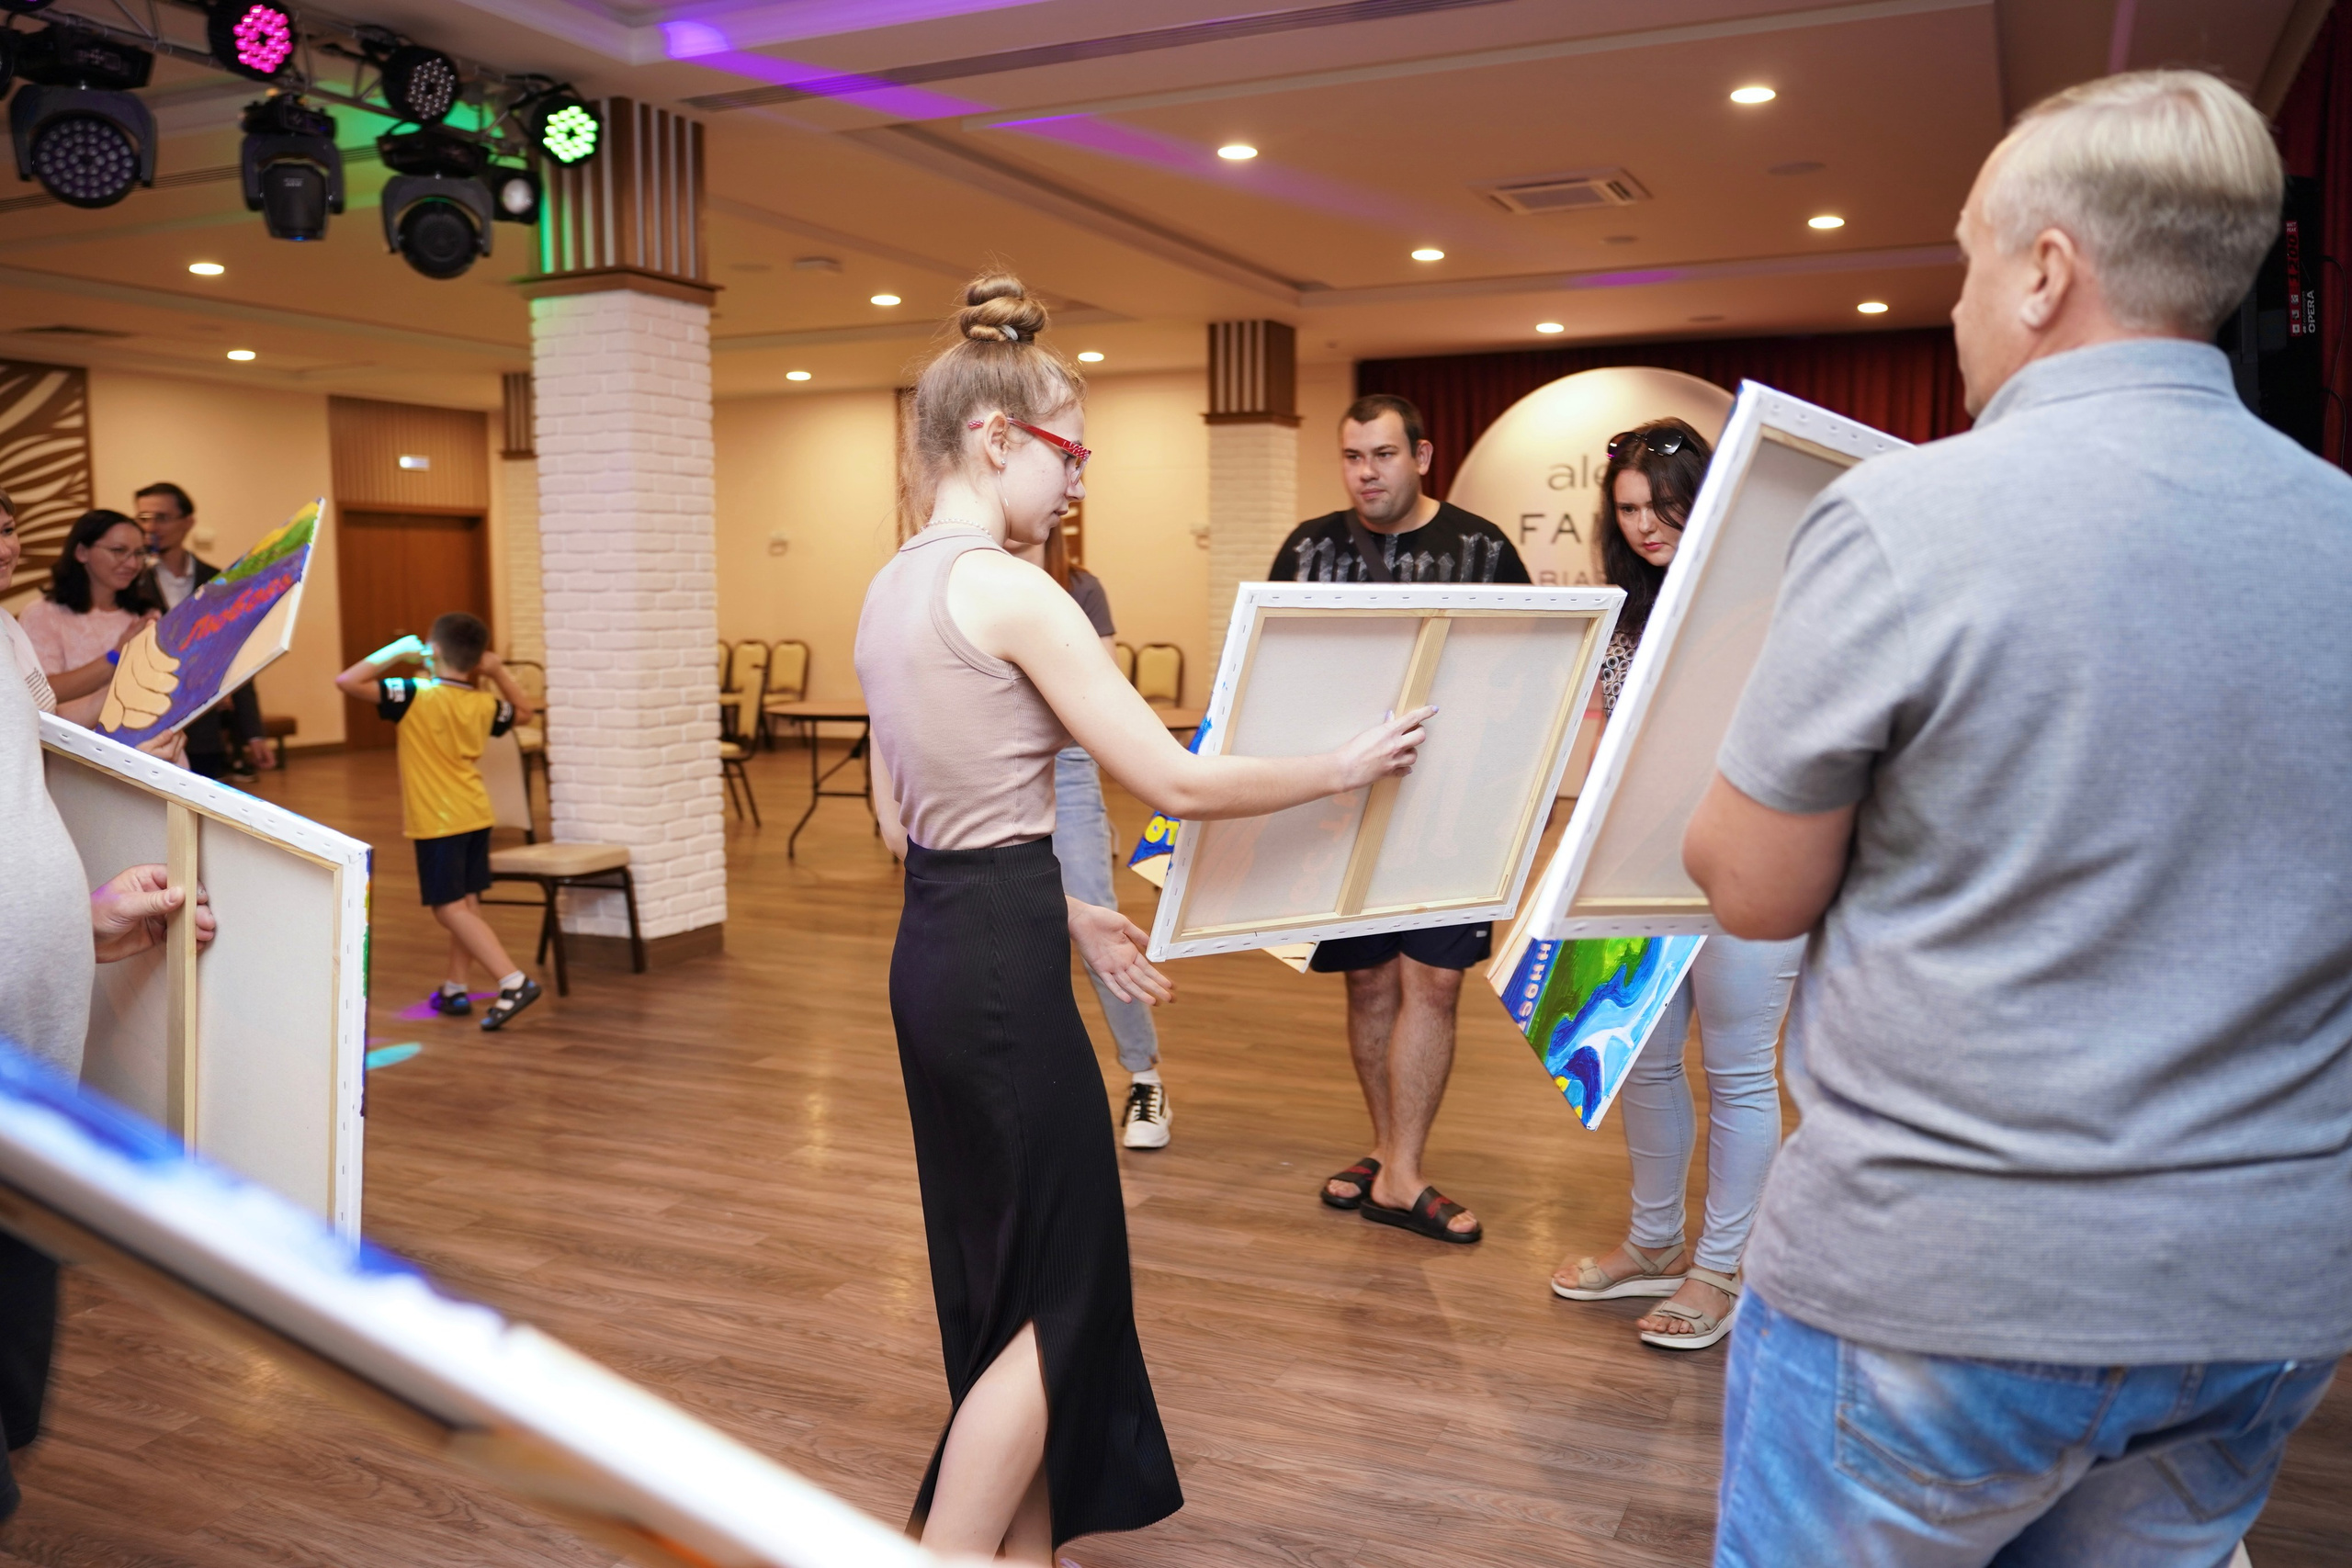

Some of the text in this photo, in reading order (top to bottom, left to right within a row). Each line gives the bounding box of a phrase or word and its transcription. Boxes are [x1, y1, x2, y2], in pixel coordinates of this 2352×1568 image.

[2288, 235, 2299, 282] 1200
[2307, 290, 2315, 333] OPERA
[1520, 513, 1601, 545] FA
